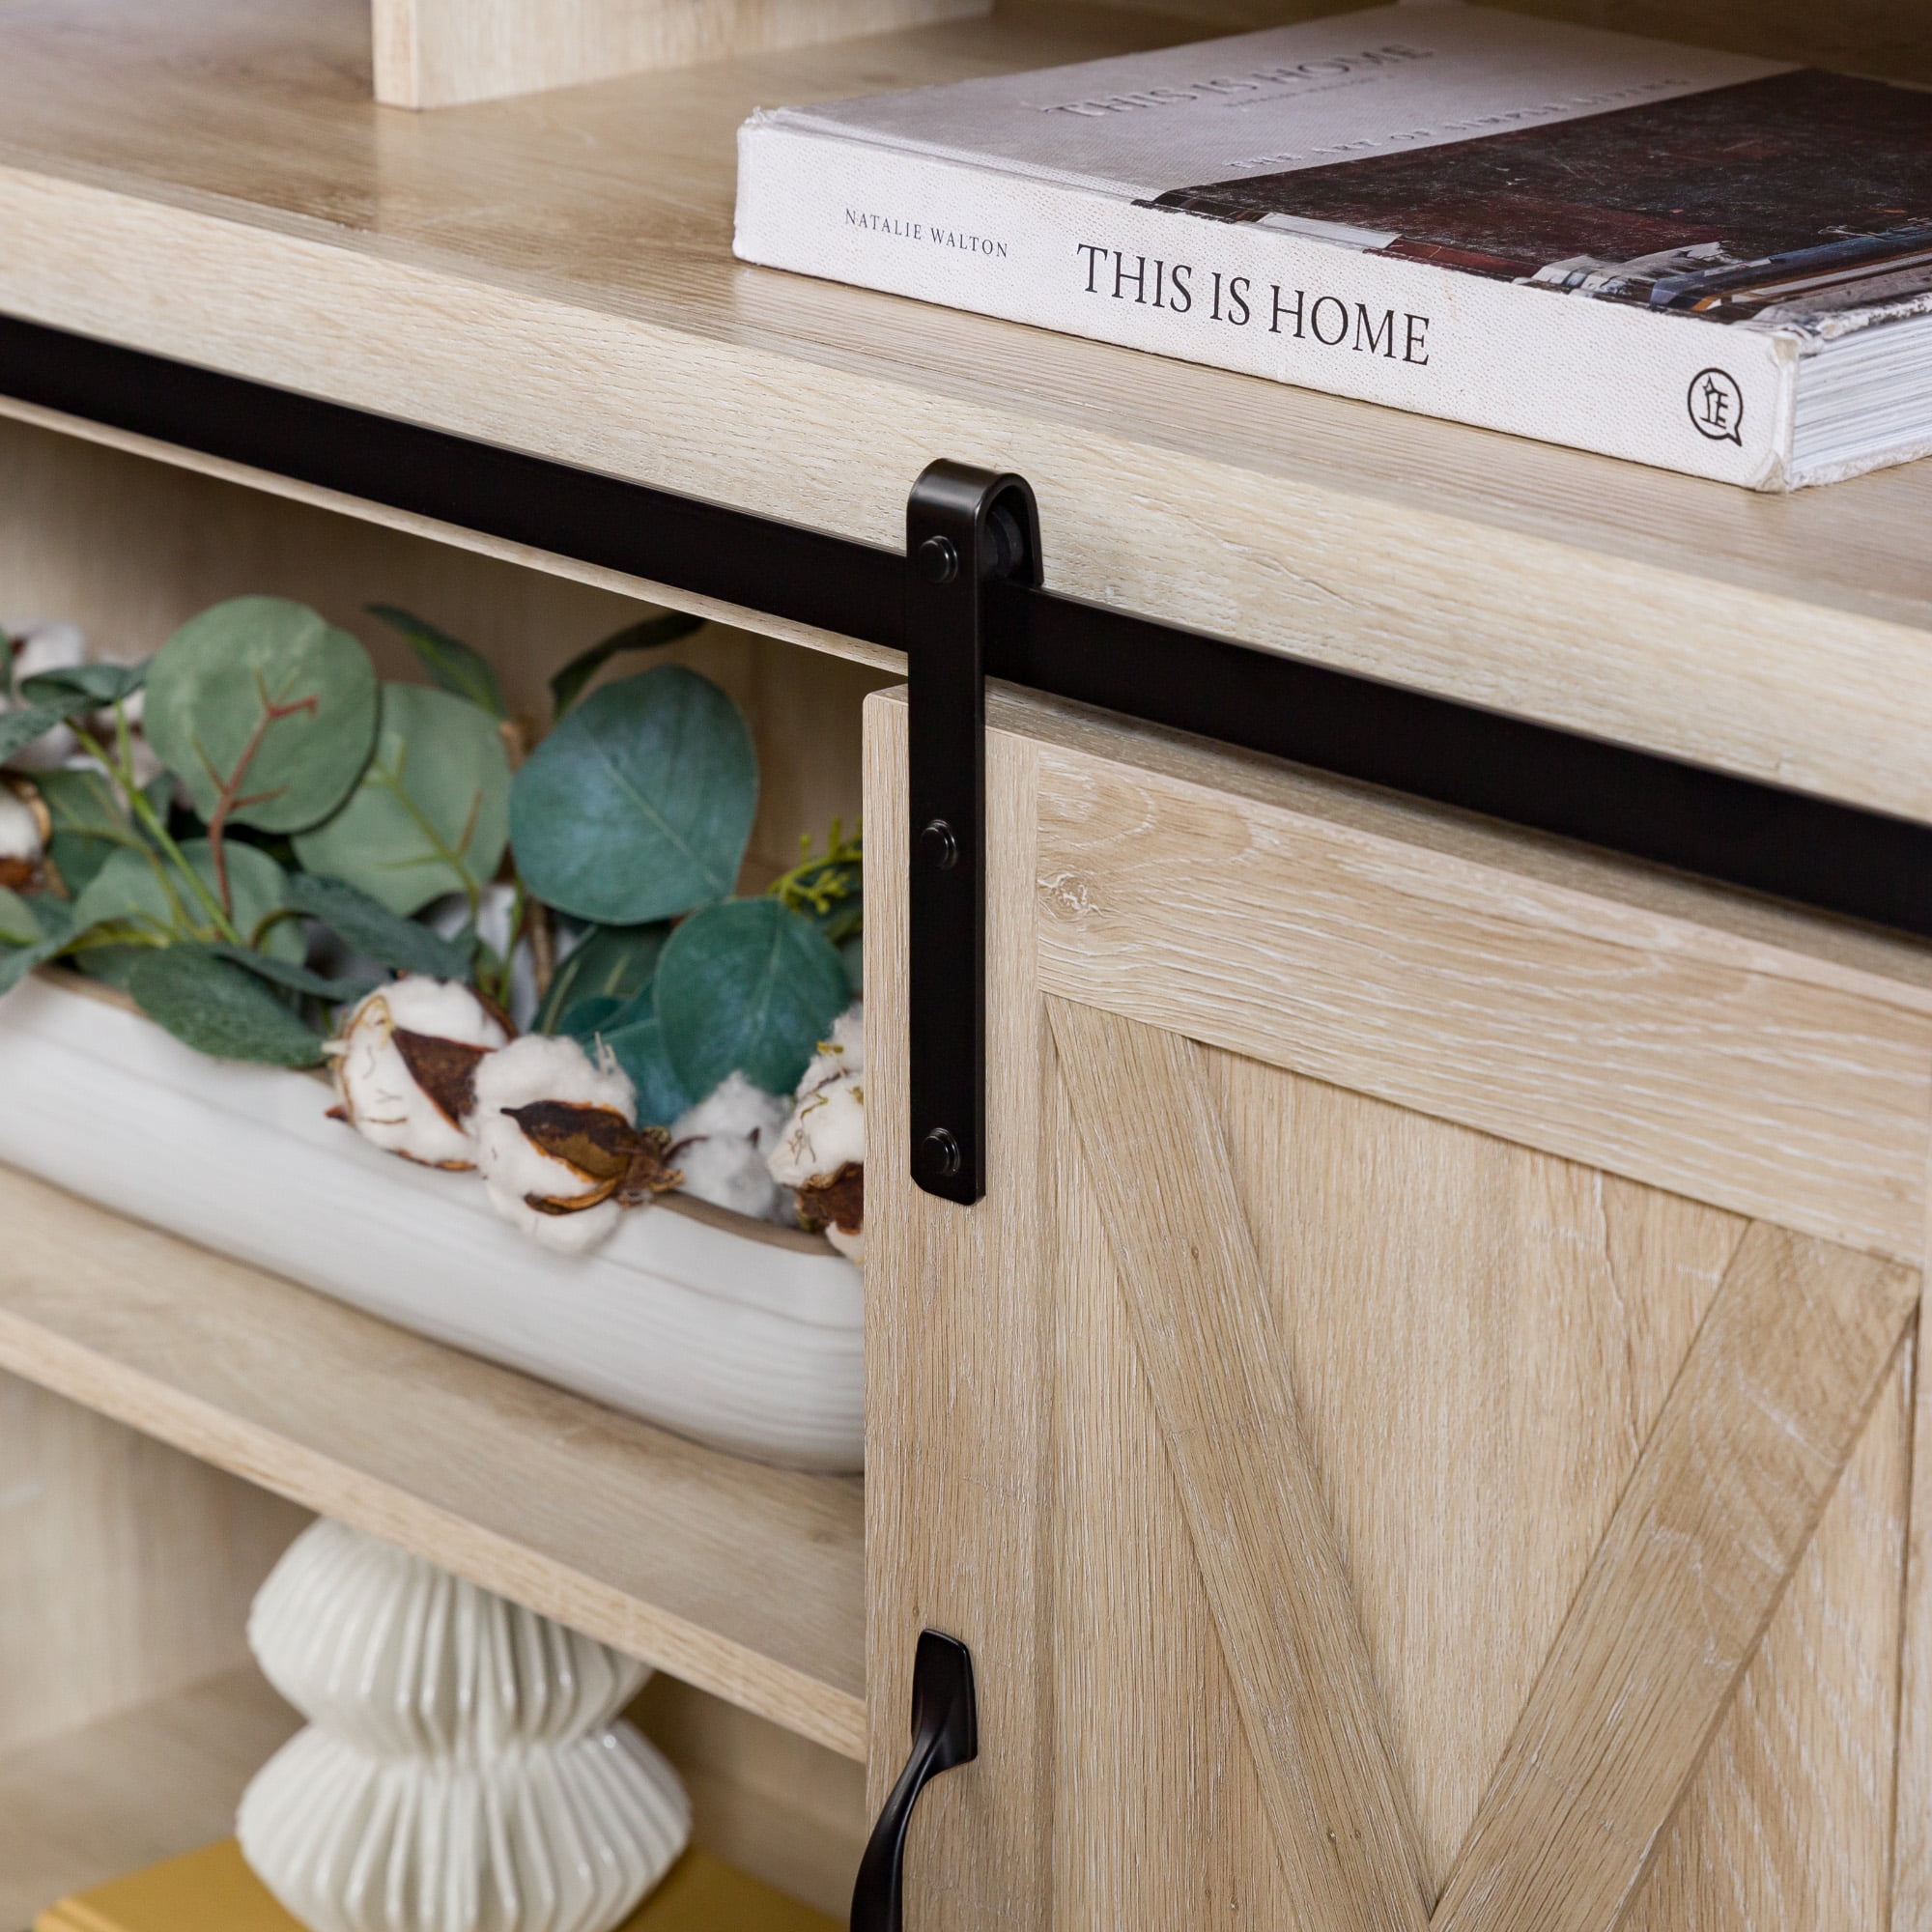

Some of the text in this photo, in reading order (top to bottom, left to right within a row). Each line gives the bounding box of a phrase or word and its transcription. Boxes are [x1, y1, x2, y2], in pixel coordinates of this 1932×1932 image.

[845, 208, 1009, 259] NATALIE WALTON
[1076, 242, 1431, 366] THIS IS HOME
